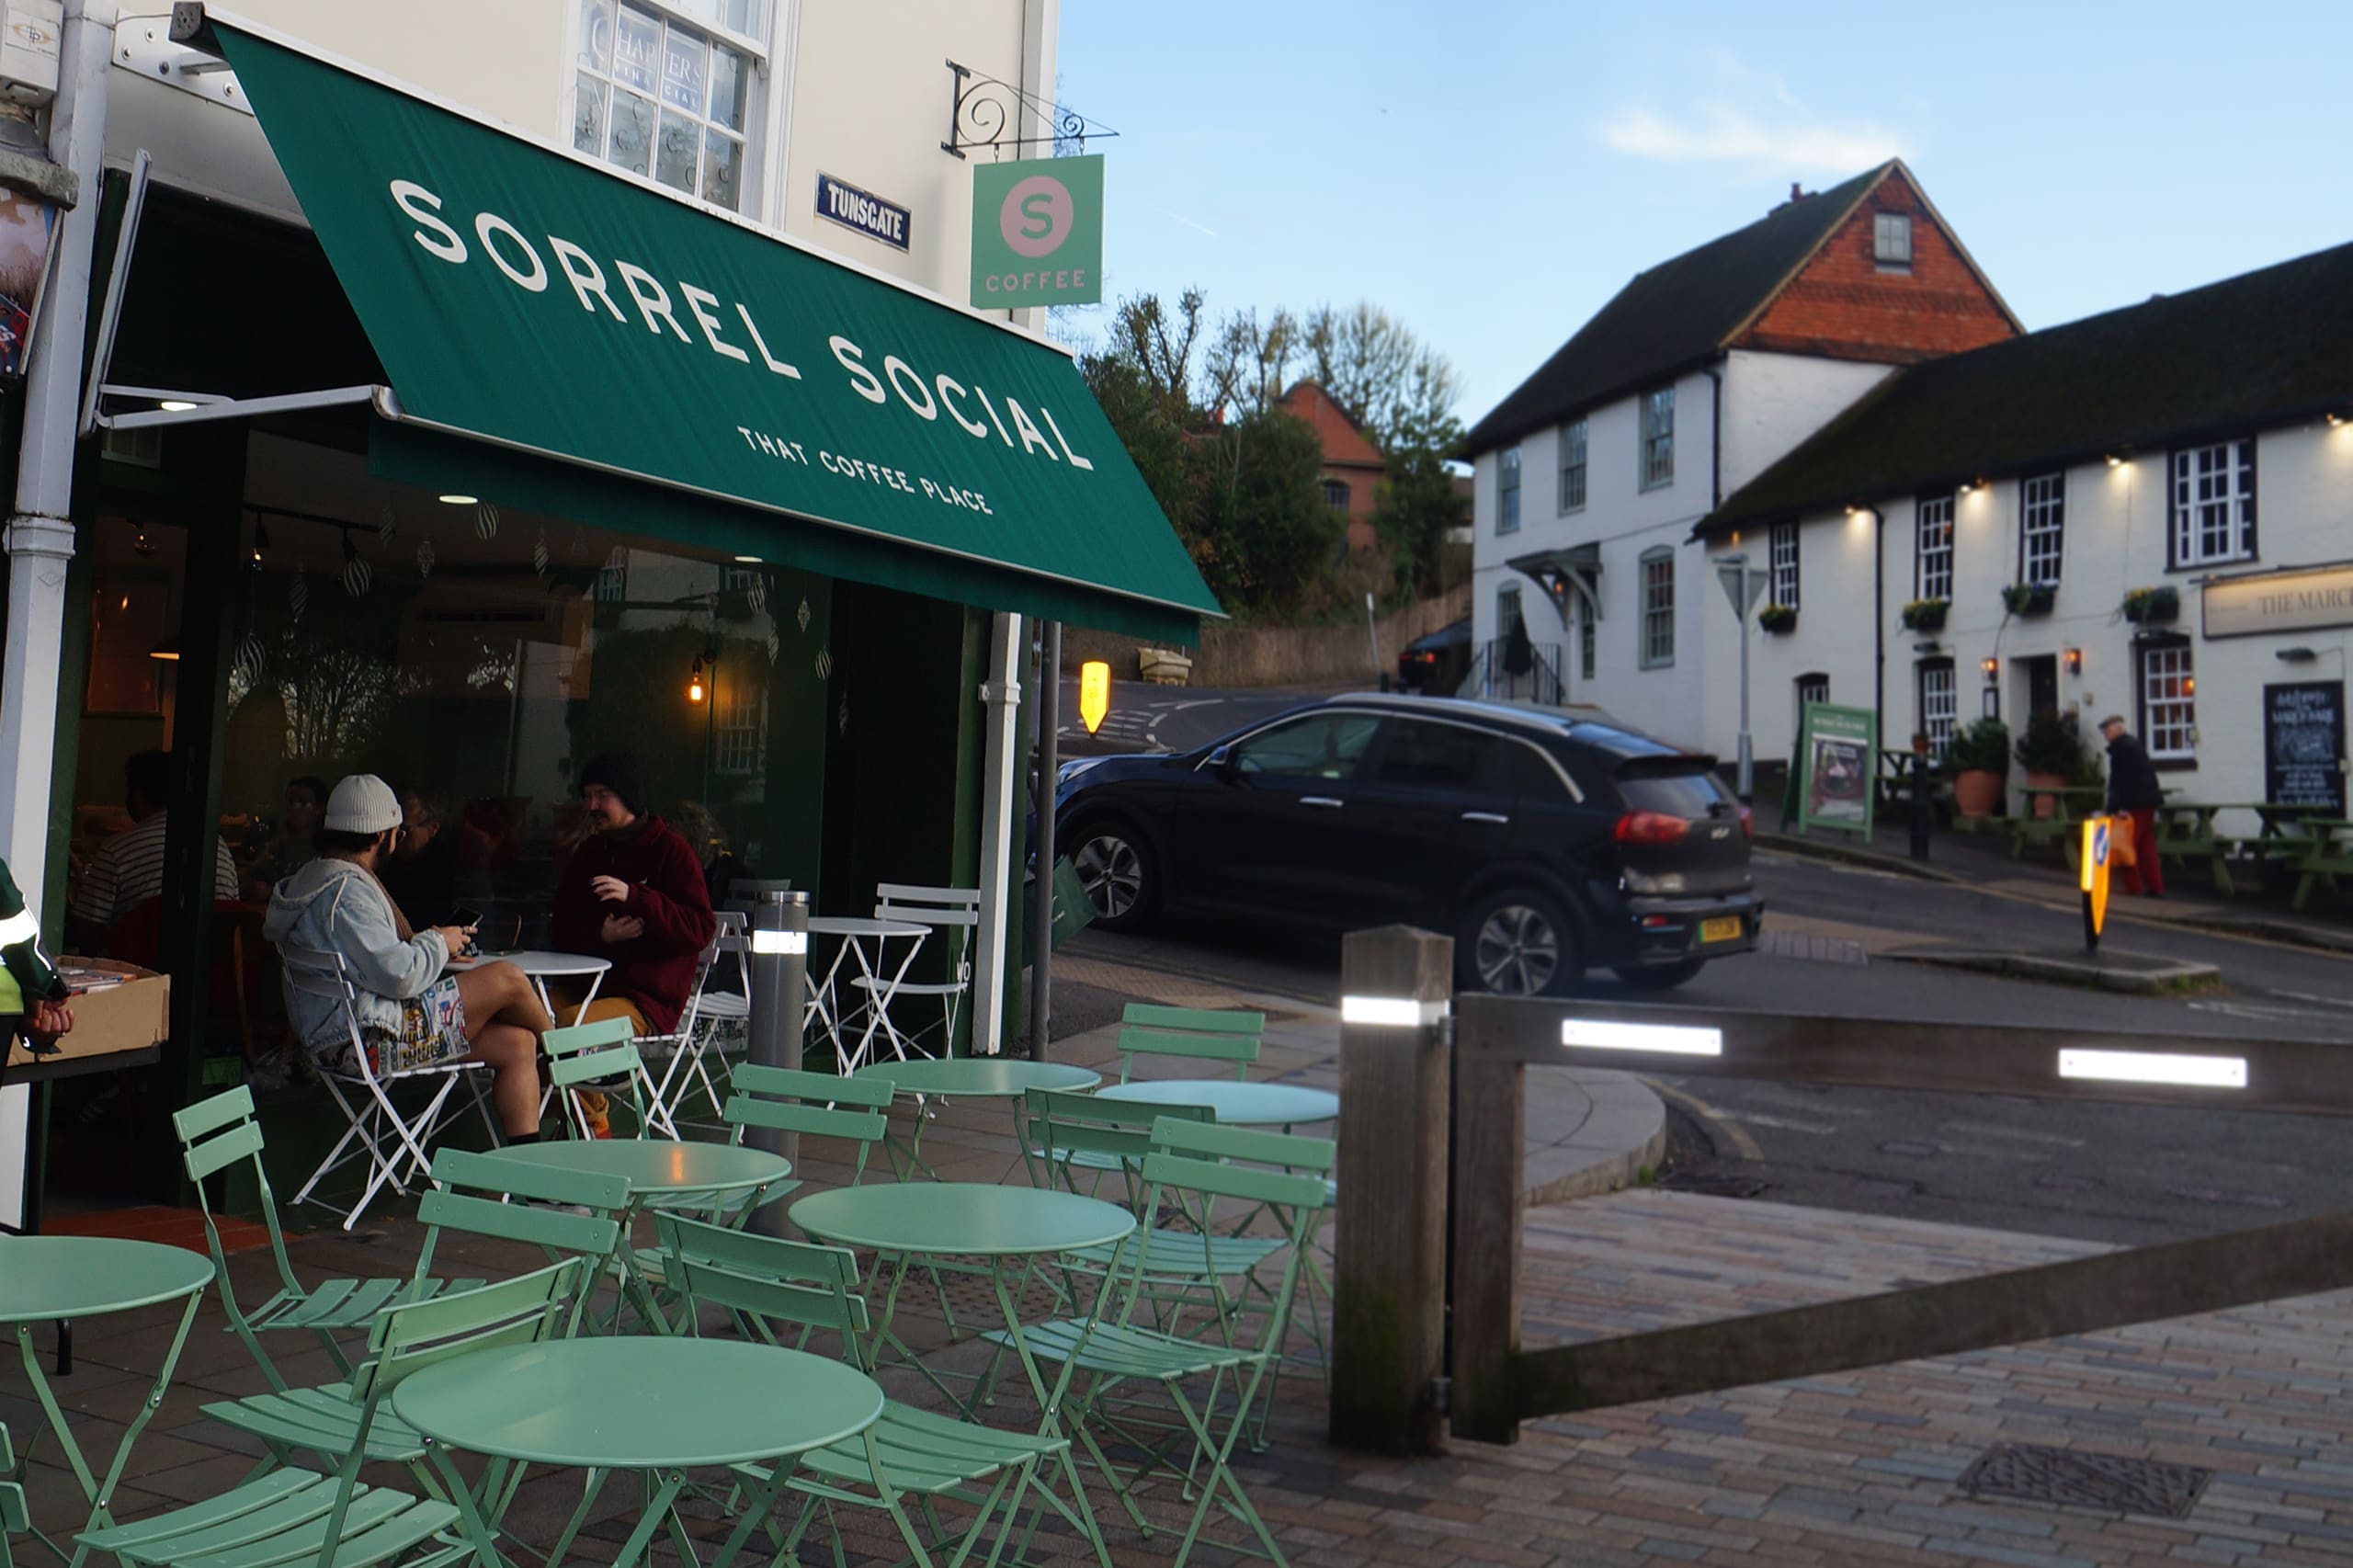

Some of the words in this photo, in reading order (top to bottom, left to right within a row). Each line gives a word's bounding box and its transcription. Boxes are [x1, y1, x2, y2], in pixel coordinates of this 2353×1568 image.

[591, 17, 702, 87] CHAPERS
[615, 64, 698, 108] FINACIAL
[828, 183, 903, 241] TUNSGATE
[1020, 193, 1053, 239] S
[985, 269, 1086, 292] COFFEE
[390, 179, 801, 380] SORREL
[829, 335, 1094, 471] SOCIAL
[737, 426, 808, 466] THAT
[820, 450, 915, 494] COFFEE
[919, 477, 993, 515] PLACE
[2258, 593, 2295, 615] THE
[2299, 587, 2353, 610] MARC
